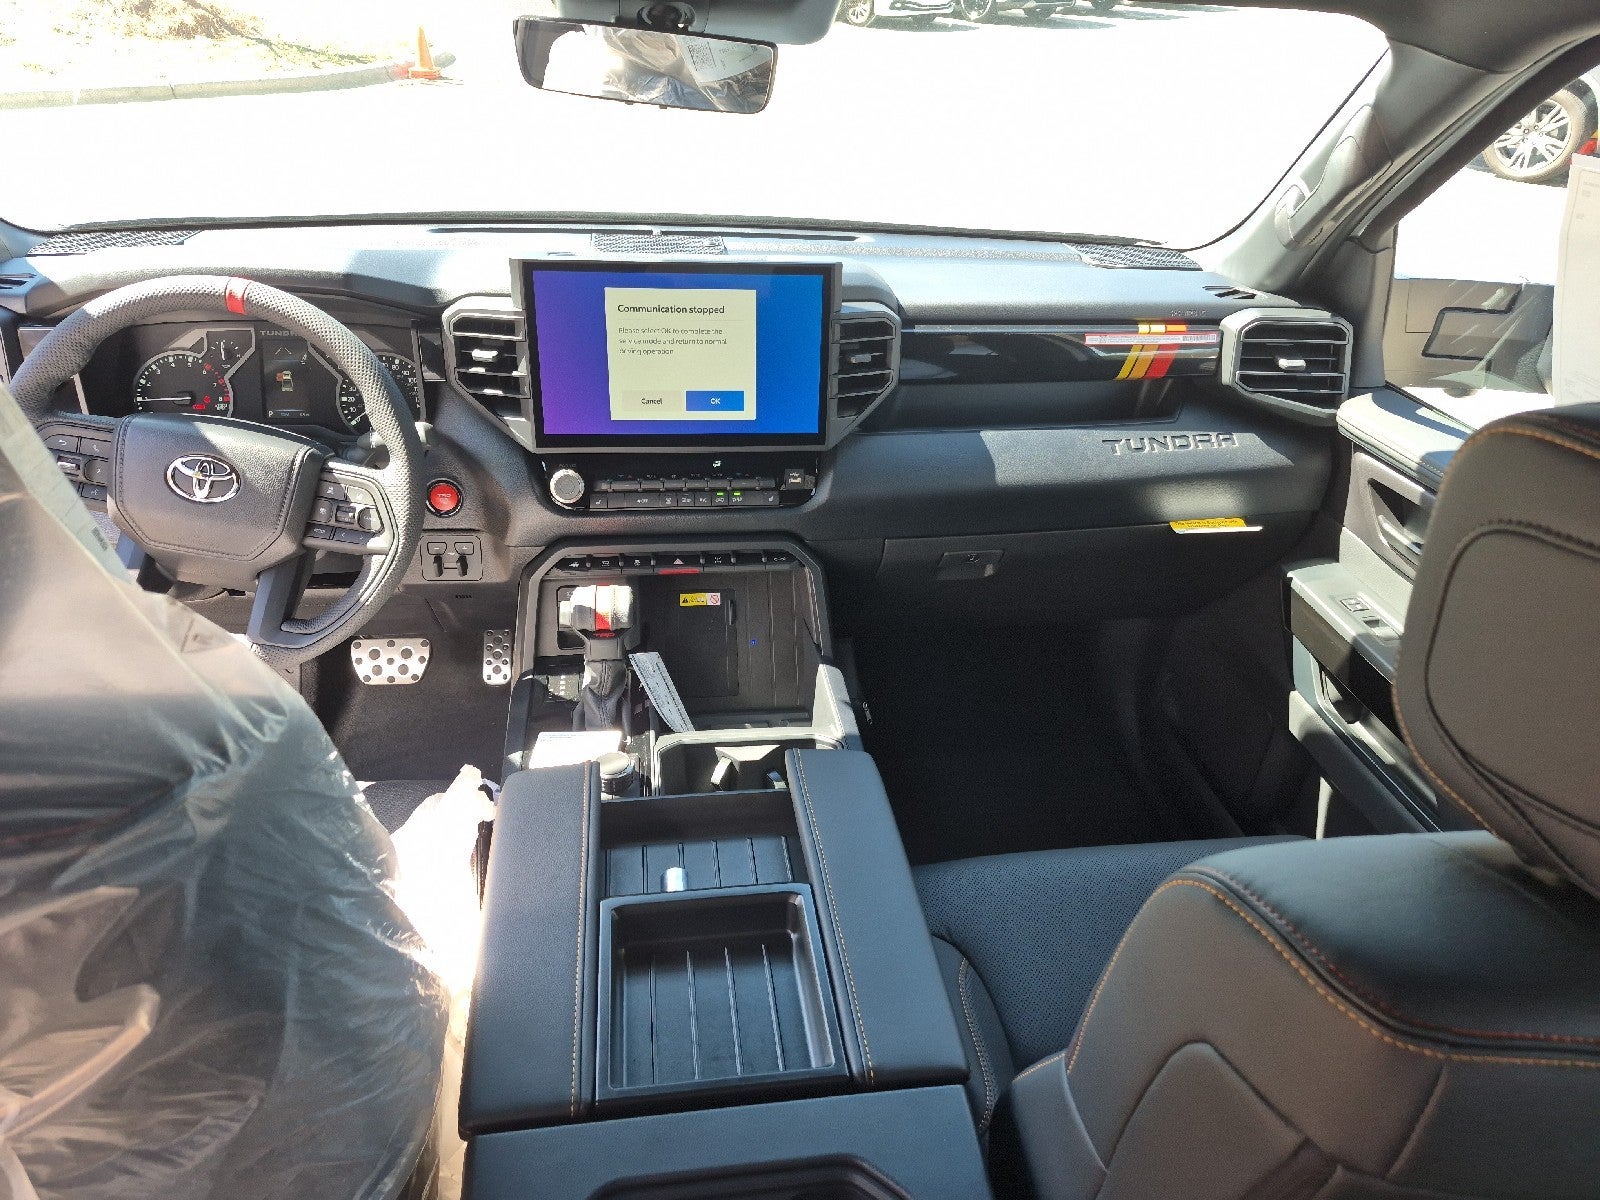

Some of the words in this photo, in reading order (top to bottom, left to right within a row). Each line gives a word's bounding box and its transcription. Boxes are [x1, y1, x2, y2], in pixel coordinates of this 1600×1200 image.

[618, 304, 687, 314] Communication
[689, 305, 725, 316] stopped
[1102, 433, 1239, 456] TUNDRA
